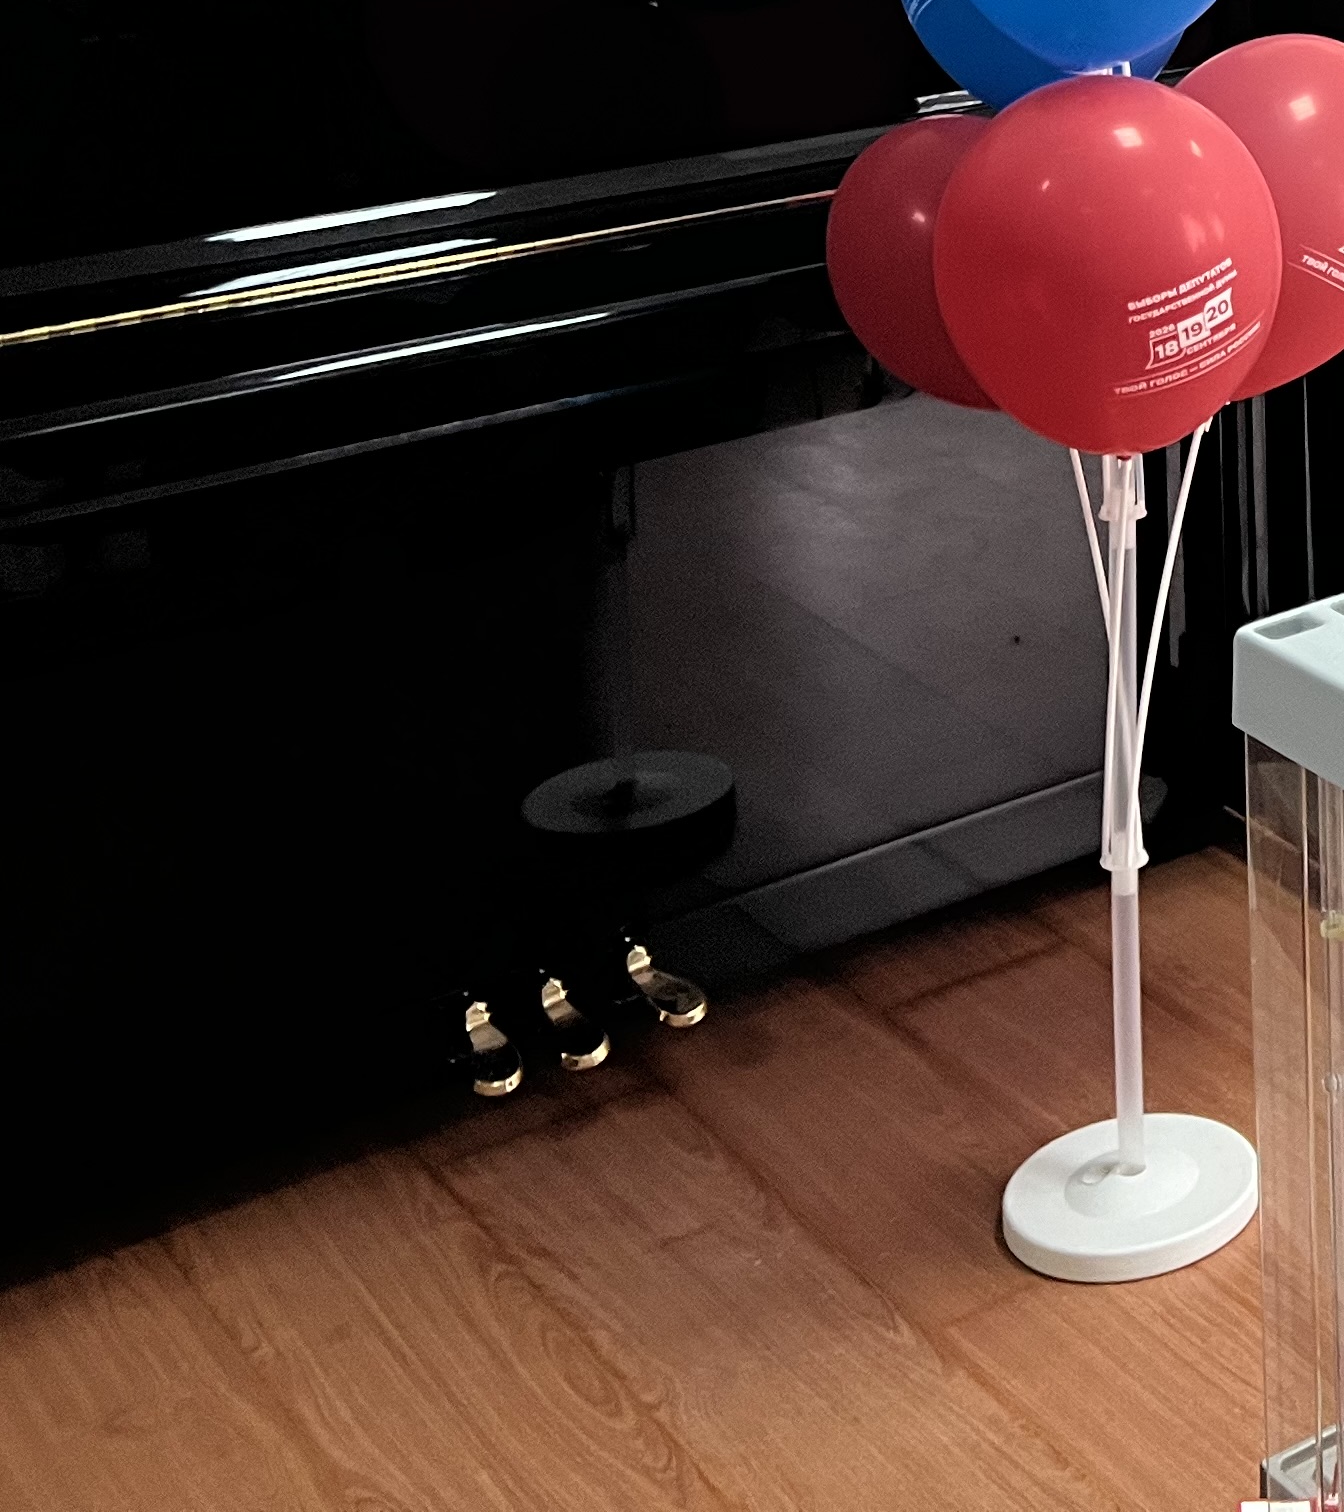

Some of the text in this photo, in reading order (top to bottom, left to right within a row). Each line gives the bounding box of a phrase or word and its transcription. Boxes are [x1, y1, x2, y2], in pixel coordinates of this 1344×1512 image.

[1127, 287, 1178, 311] ВЫБОРЫ
[1206, 299, 1229, 323] 20
[1181, 322, 1204, 341] 19
[1154, 340, 1180, 360] 18
[1113, 382, 1148, 395] ТВОЙ
[1149, 369, 1189, 388] ГОЛОС
